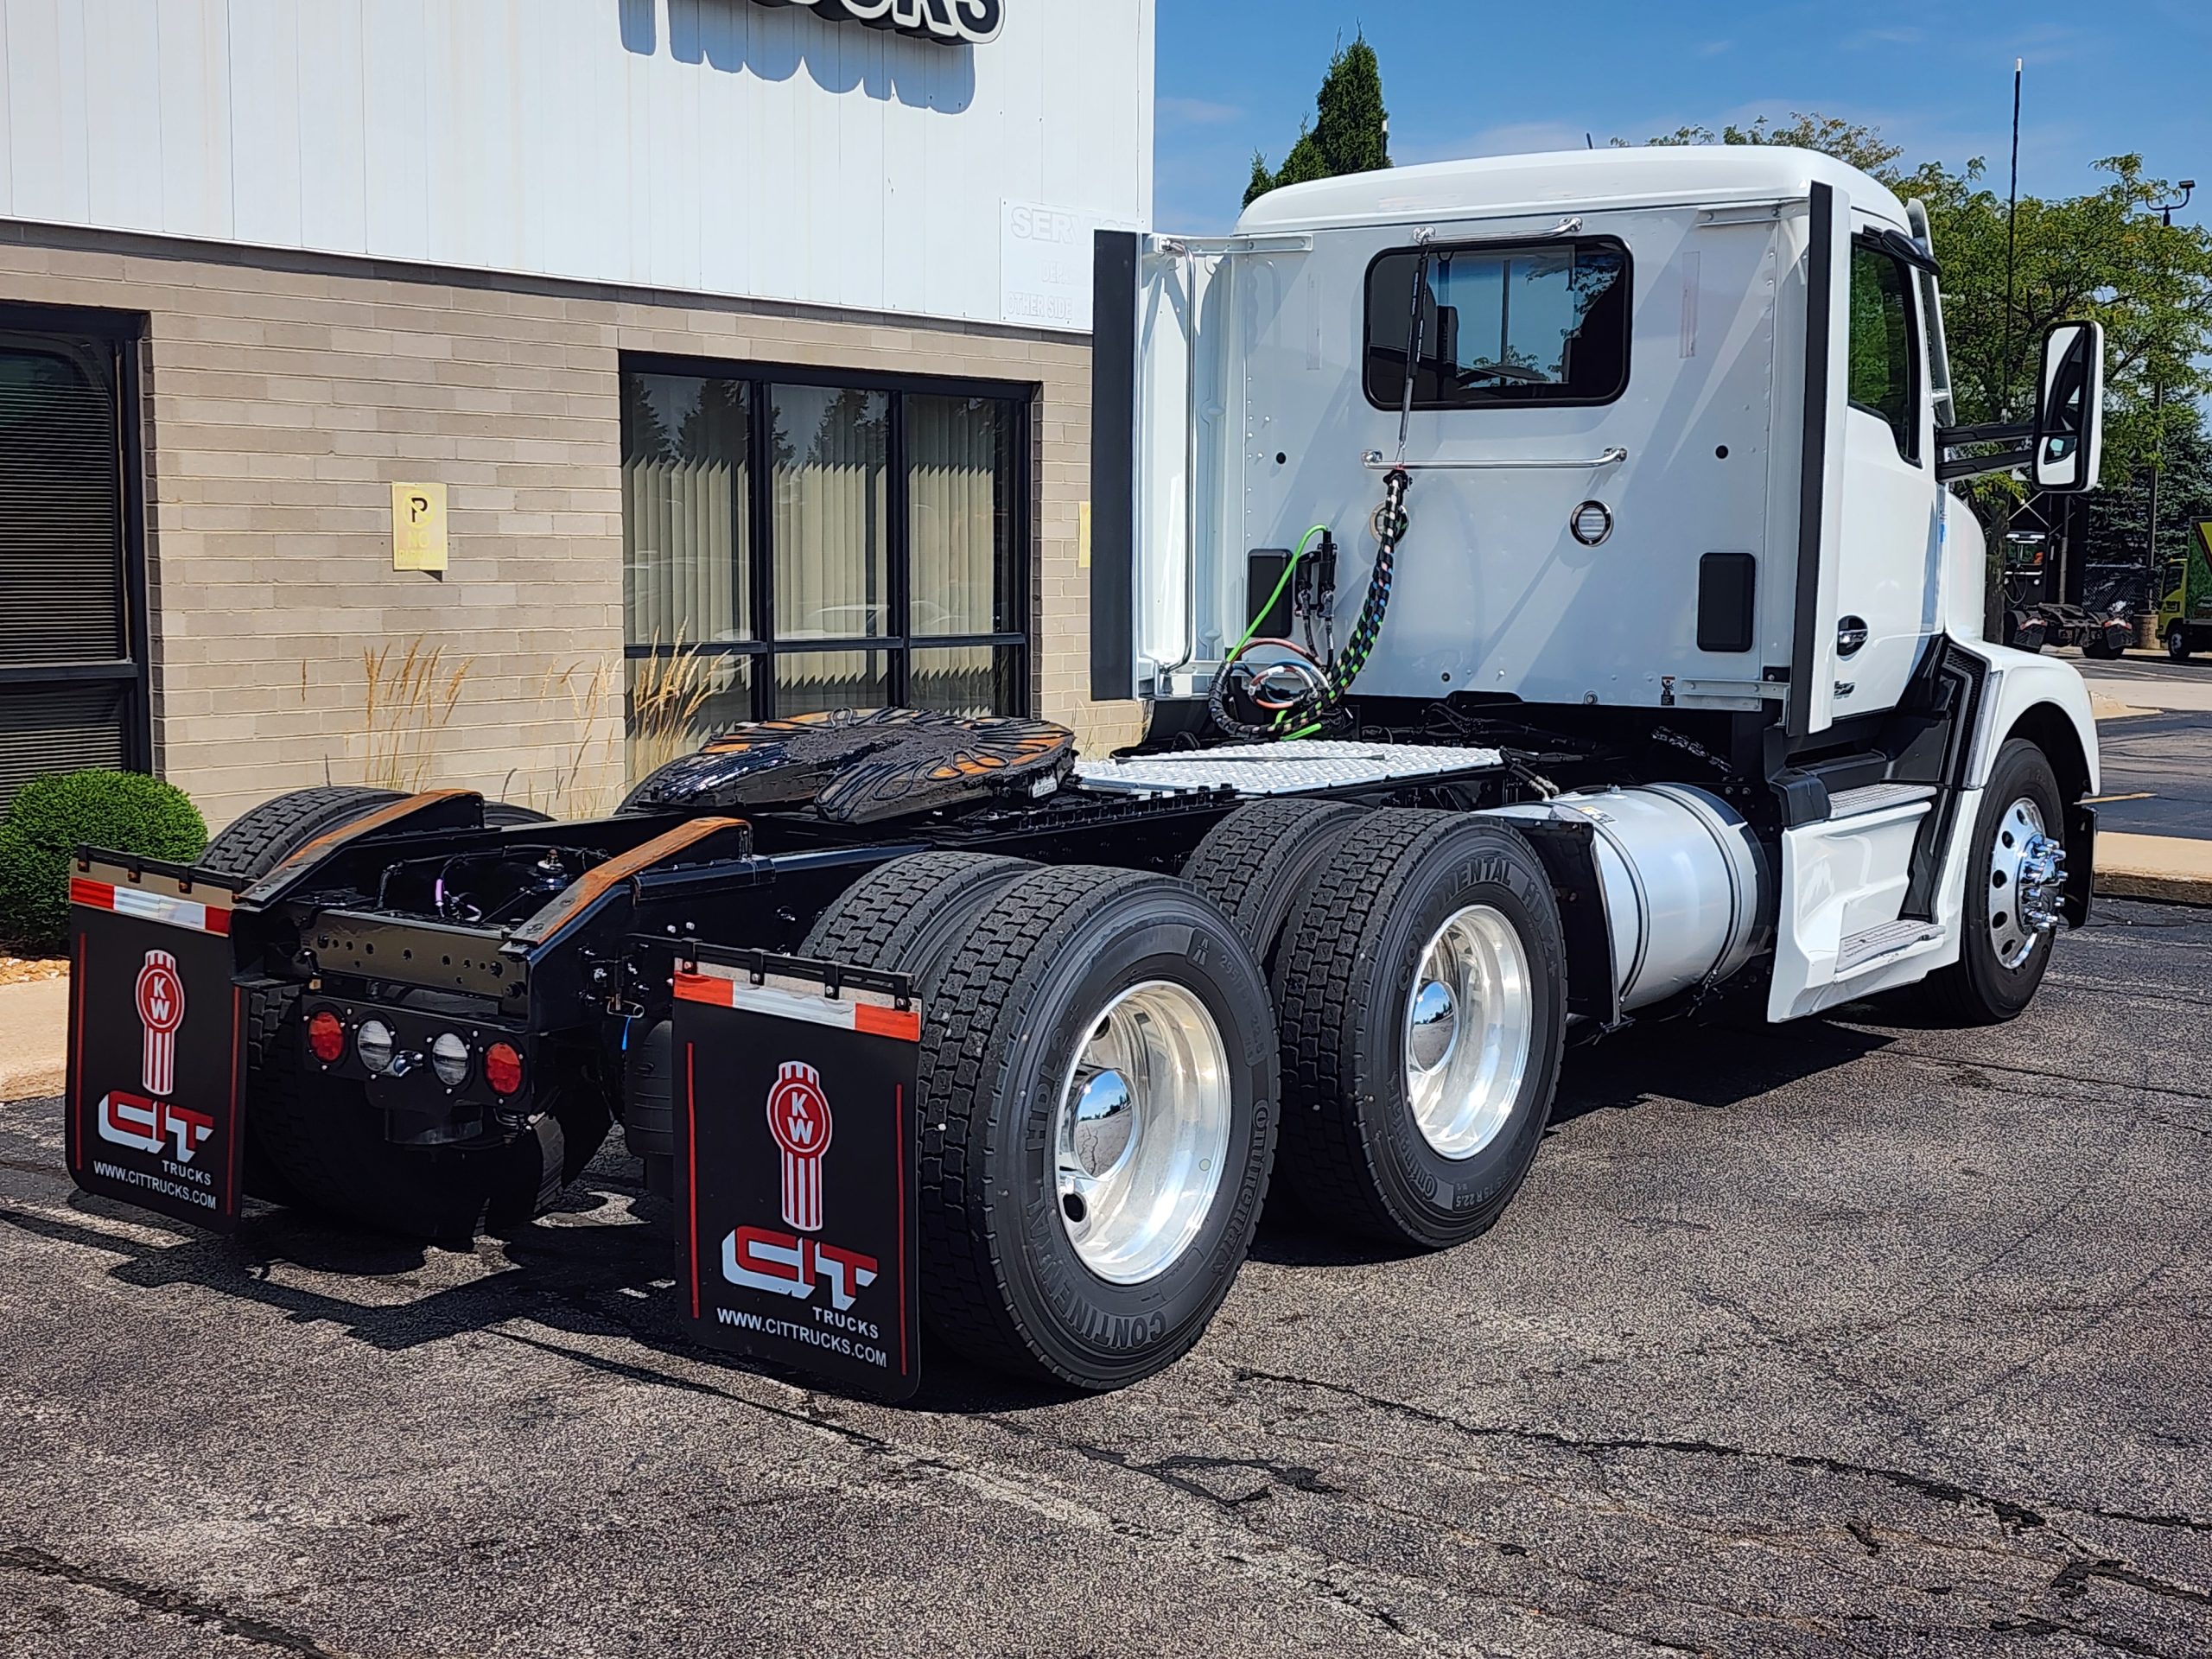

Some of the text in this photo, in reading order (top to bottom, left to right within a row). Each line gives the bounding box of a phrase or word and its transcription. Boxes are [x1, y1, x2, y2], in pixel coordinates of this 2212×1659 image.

[1007, 291, 1072, 321] OTHER SIDE
[407, 530, 429, 548] NO
[154, 977, 166, 998] K
[150, 1000, 170, 1021] W
[792, 1092, 807, 1118] K
[788, 1116, 813, 1144] W
[92, 1160, 217, 1211] WWW.CITTRUCKS.COM
[162, 1159, 212, 1186] TRUCKS
[812, 1306, 879, 1339] TRUCKS
[716, 1306, 887, 1368] WWW.CITTRUCKS.COM
